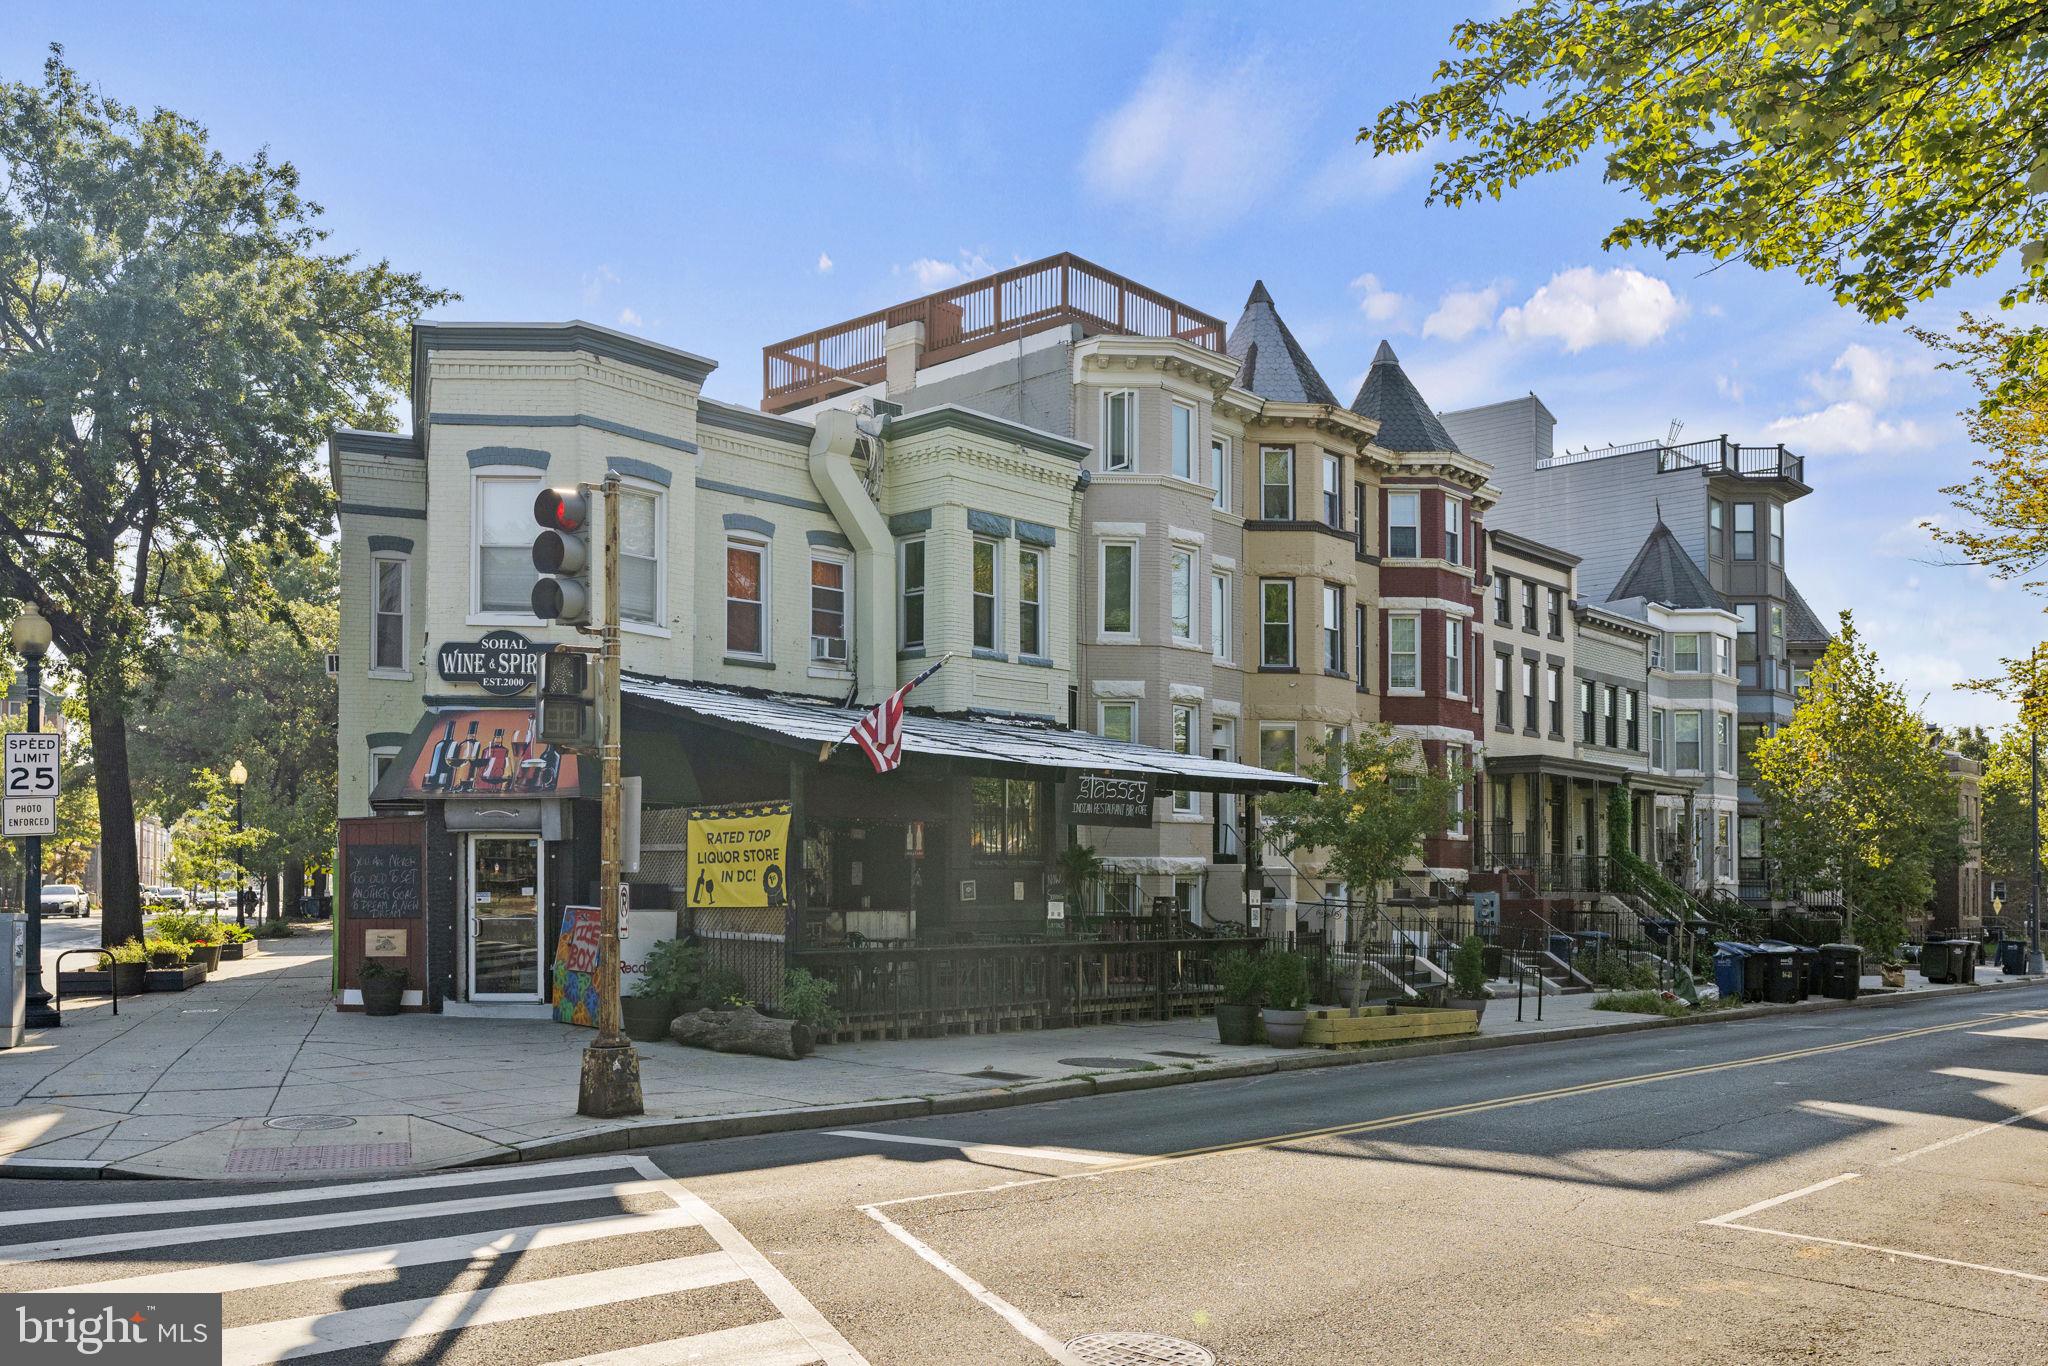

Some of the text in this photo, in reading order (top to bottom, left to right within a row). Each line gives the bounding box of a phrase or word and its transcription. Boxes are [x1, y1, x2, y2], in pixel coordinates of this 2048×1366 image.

[481, 638, 527, 649] SOHAL
[442, 648, 537, 675] WINE & SPIR
[483, 677, 524, 686] EST.2000
[10, 739, 55, 749] SPEED
[14, 753, 50, 763] LIMIT
[10, 767, 54, 790] 25
[16, 804, 42, 813] PHOTO
[1072, 802, 1093, 814] INDIAN
[1093, 802, 1125, 816] RESTAURANT
[1125, 803, 1135, 817] BAR
[9, 817, 49, 827] ENFORCED
[706, 829, 771, 845] RATED TOP
[697, 848, 780, 864] LIQUOR STORE
[721, 869, 756, 882] IN DC!
[567, 943, 595, 971] BOX
